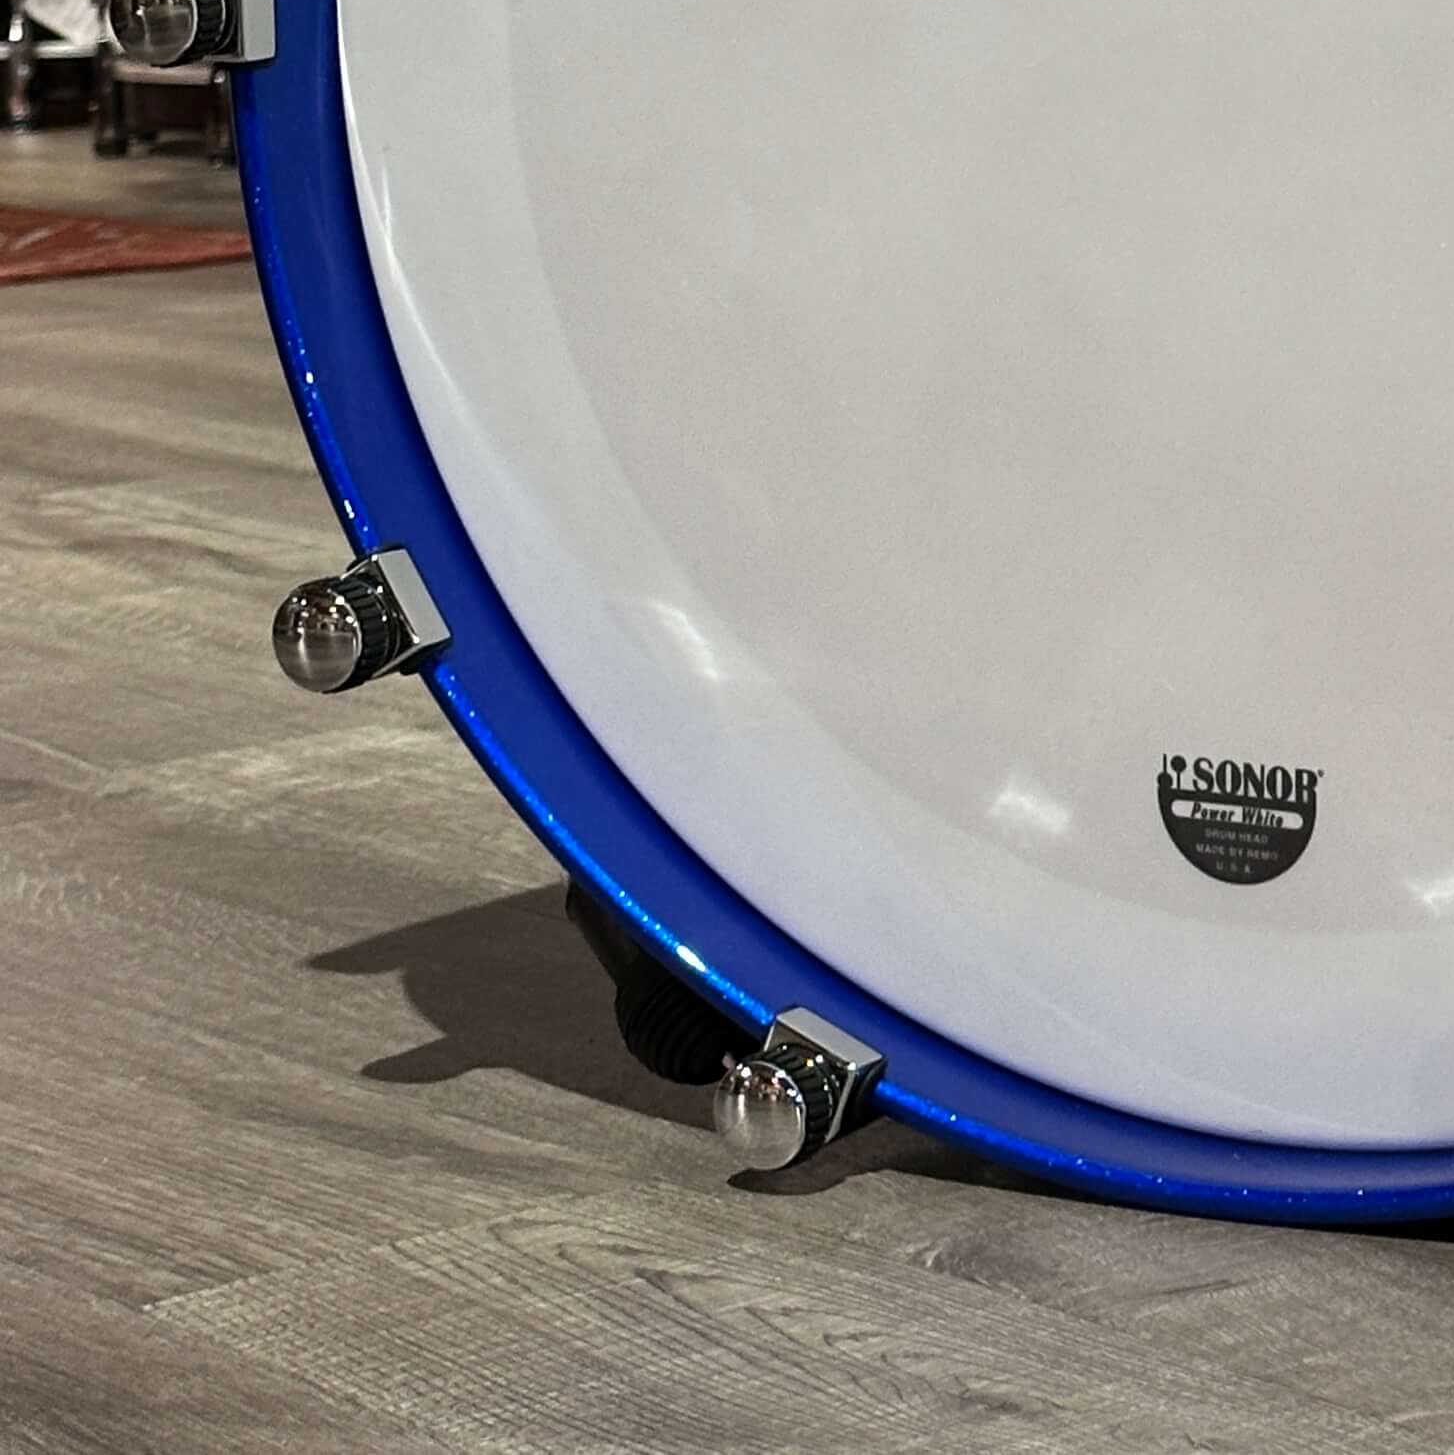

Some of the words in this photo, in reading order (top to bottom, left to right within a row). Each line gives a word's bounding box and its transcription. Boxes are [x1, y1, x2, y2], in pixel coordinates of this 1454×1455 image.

[1191, 801, 1235, 821] Power
[1241, 806, 1285, 828] White
[1204, 828, 1236, 841] DRUM
[1239, 833, 1269, 844] HEAD
[1195, 843, 1225, 856] MADE
